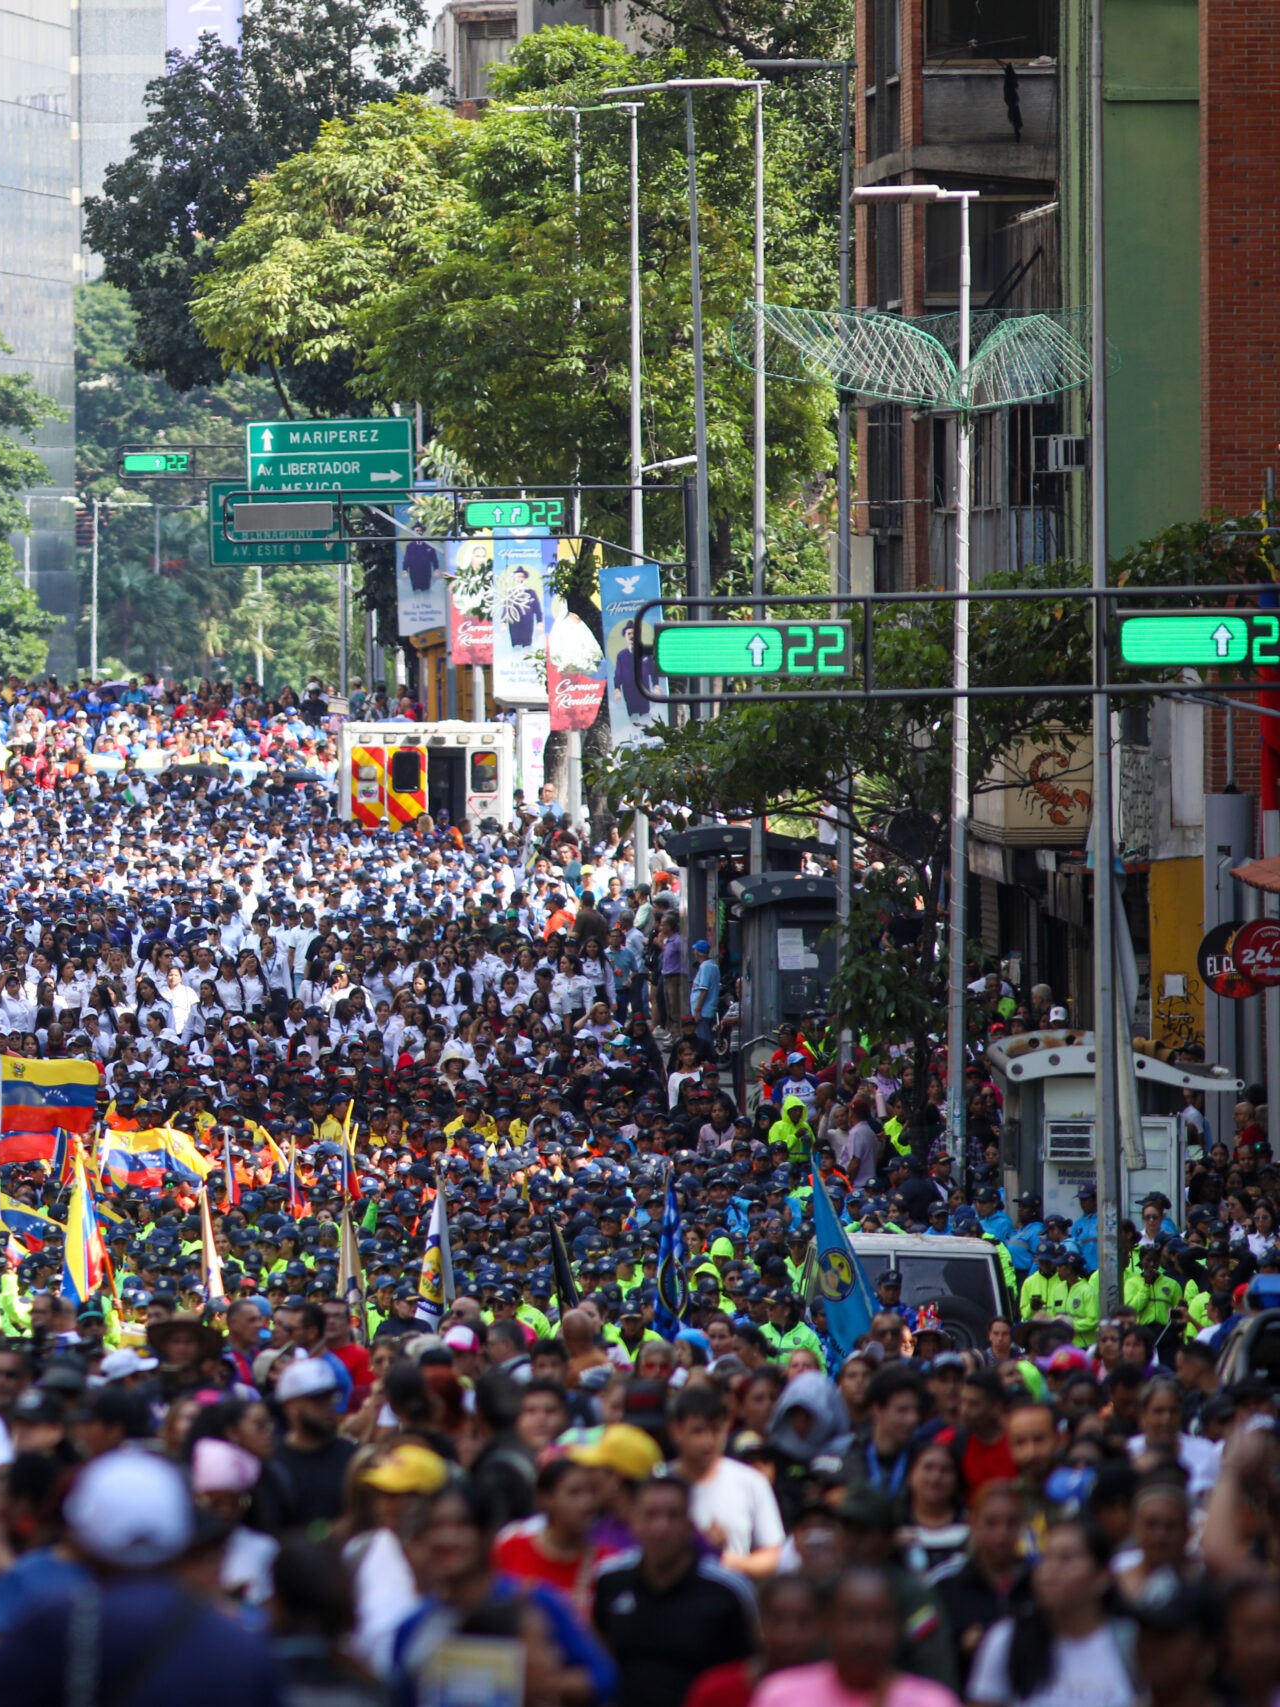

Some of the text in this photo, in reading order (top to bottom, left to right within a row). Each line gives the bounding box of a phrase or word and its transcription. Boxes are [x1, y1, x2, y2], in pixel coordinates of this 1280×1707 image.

[289, 429, 379, 444] MARIPEREZ
[166, 454, 188, 471] 22
[280, 461, 361, 476] LIBERTADOR
[531, 501, 562, 526] 22
[257, 544, 286, 556] ESTE
[787, 625, 845, 674] 22
[555, 678, 601, 695] Carmen
[1242, 946, 1273, 964] 24
[1206, 956, 1220, 976] EL
